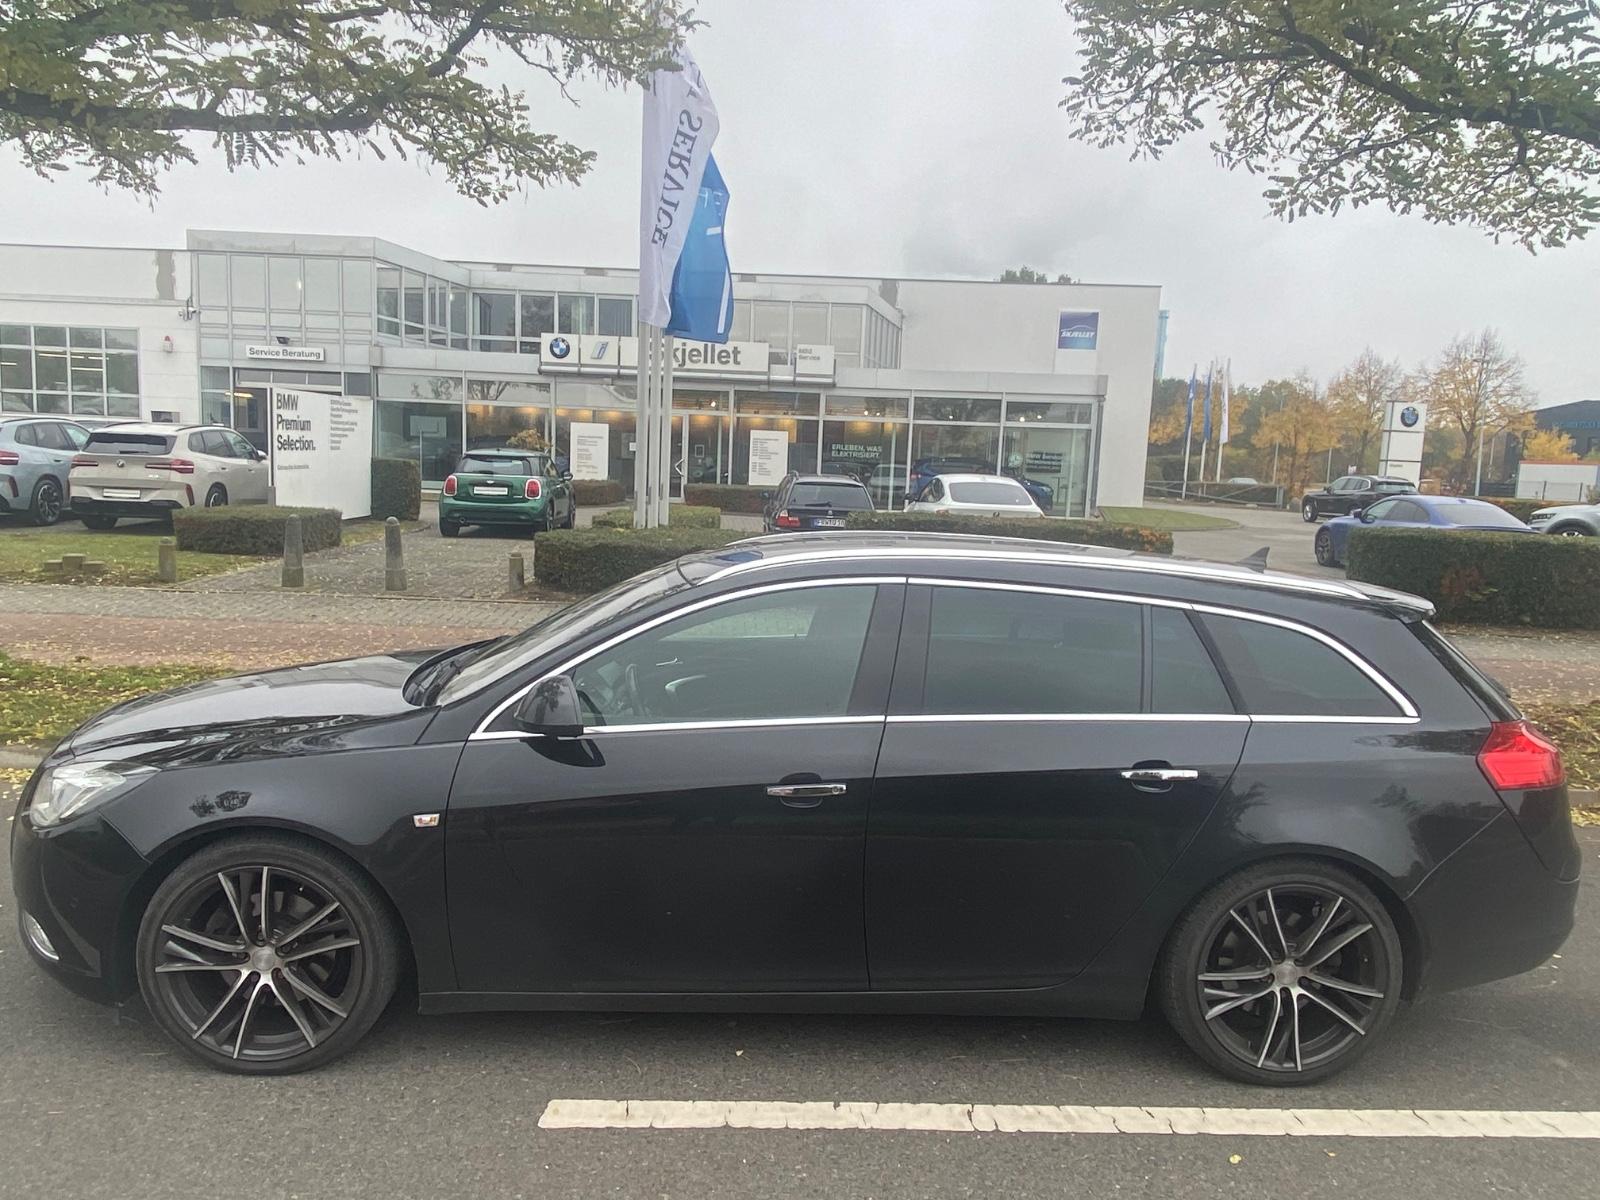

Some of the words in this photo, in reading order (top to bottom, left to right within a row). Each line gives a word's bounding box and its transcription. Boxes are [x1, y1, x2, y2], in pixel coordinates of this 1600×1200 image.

[249, 347, 280, 357] Service
[282, 348, 321, 359] Beratung
[276, 392, 299, 411] BMW
[276, 413, 312, 432] Premium
[276, 434, 316, 451] Selection.
[867, 445, 883, 453] WAS
